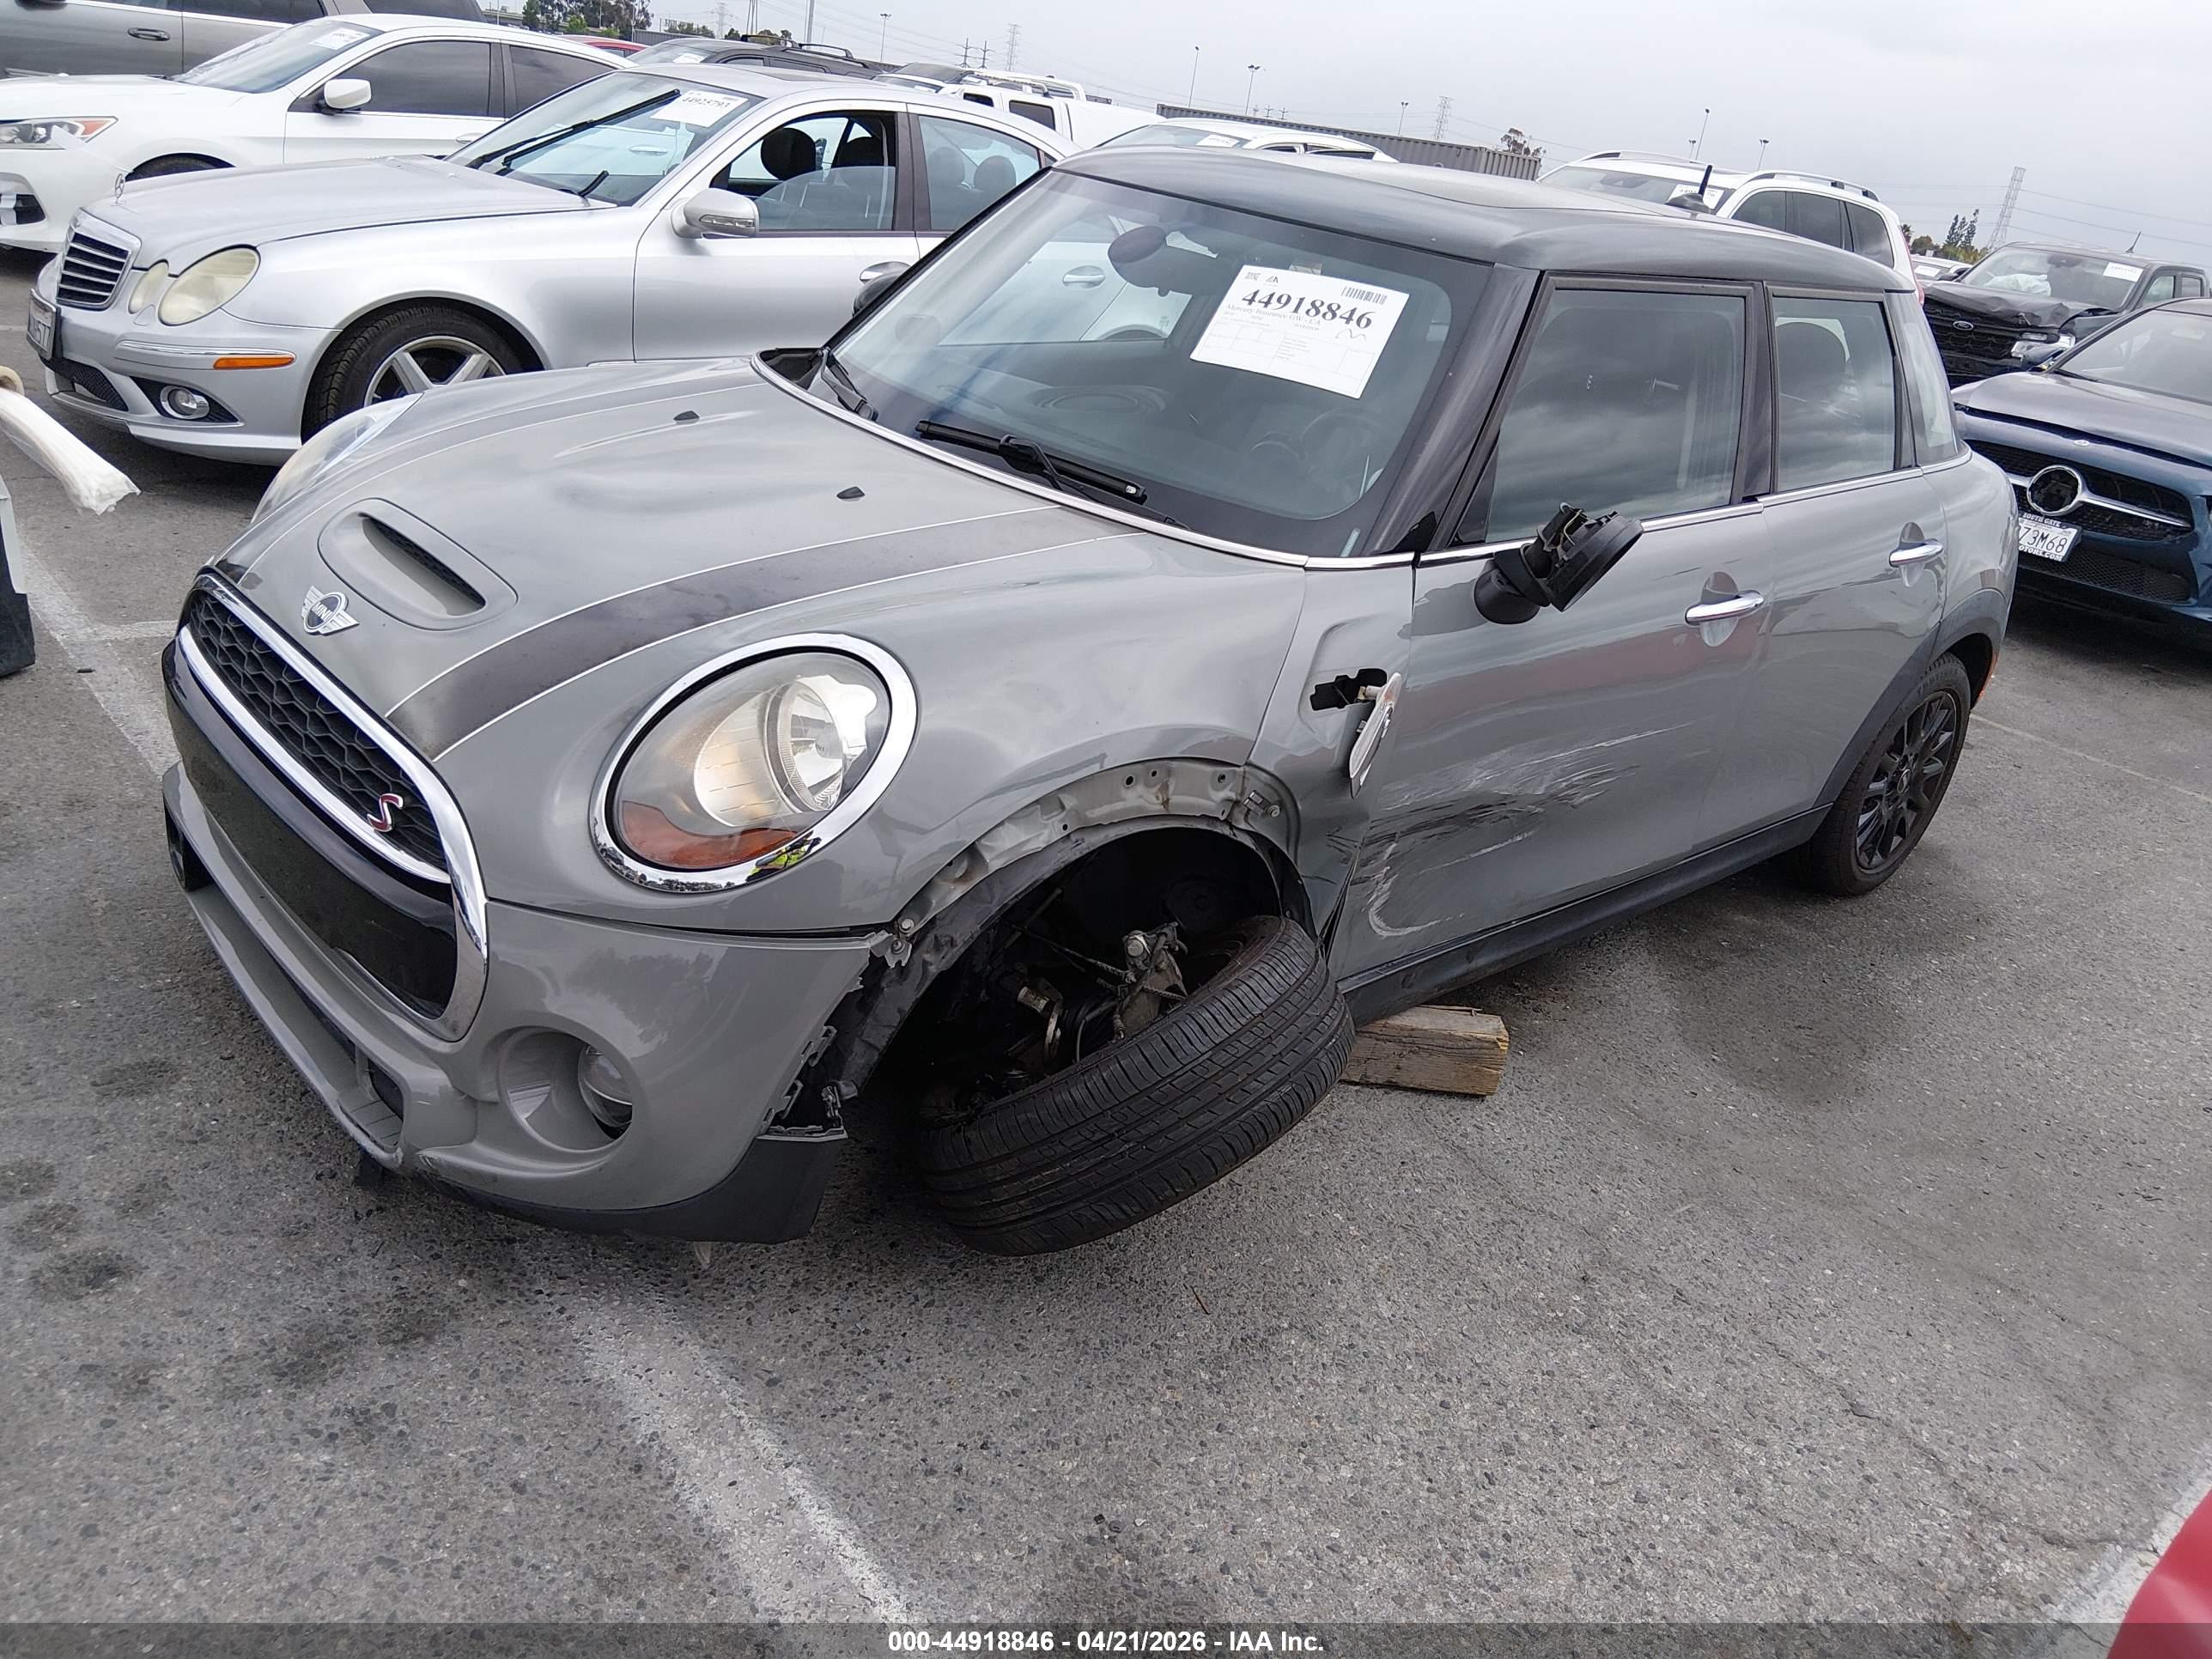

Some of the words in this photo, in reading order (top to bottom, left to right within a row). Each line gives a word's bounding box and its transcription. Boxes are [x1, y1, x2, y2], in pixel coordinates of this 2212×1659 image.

[1242, 289, 1376, 329] 44918846
[2022, 513, 2044, 523] SOUTH
[2044, 519, 2062, 527] GATE
[2019, 526, 2067, 553] 73M68
[2018, 544, 2064, 562] OTORS.COM
[312, 601, 333, 622] MINI
[367, 793, 404, 832] S
